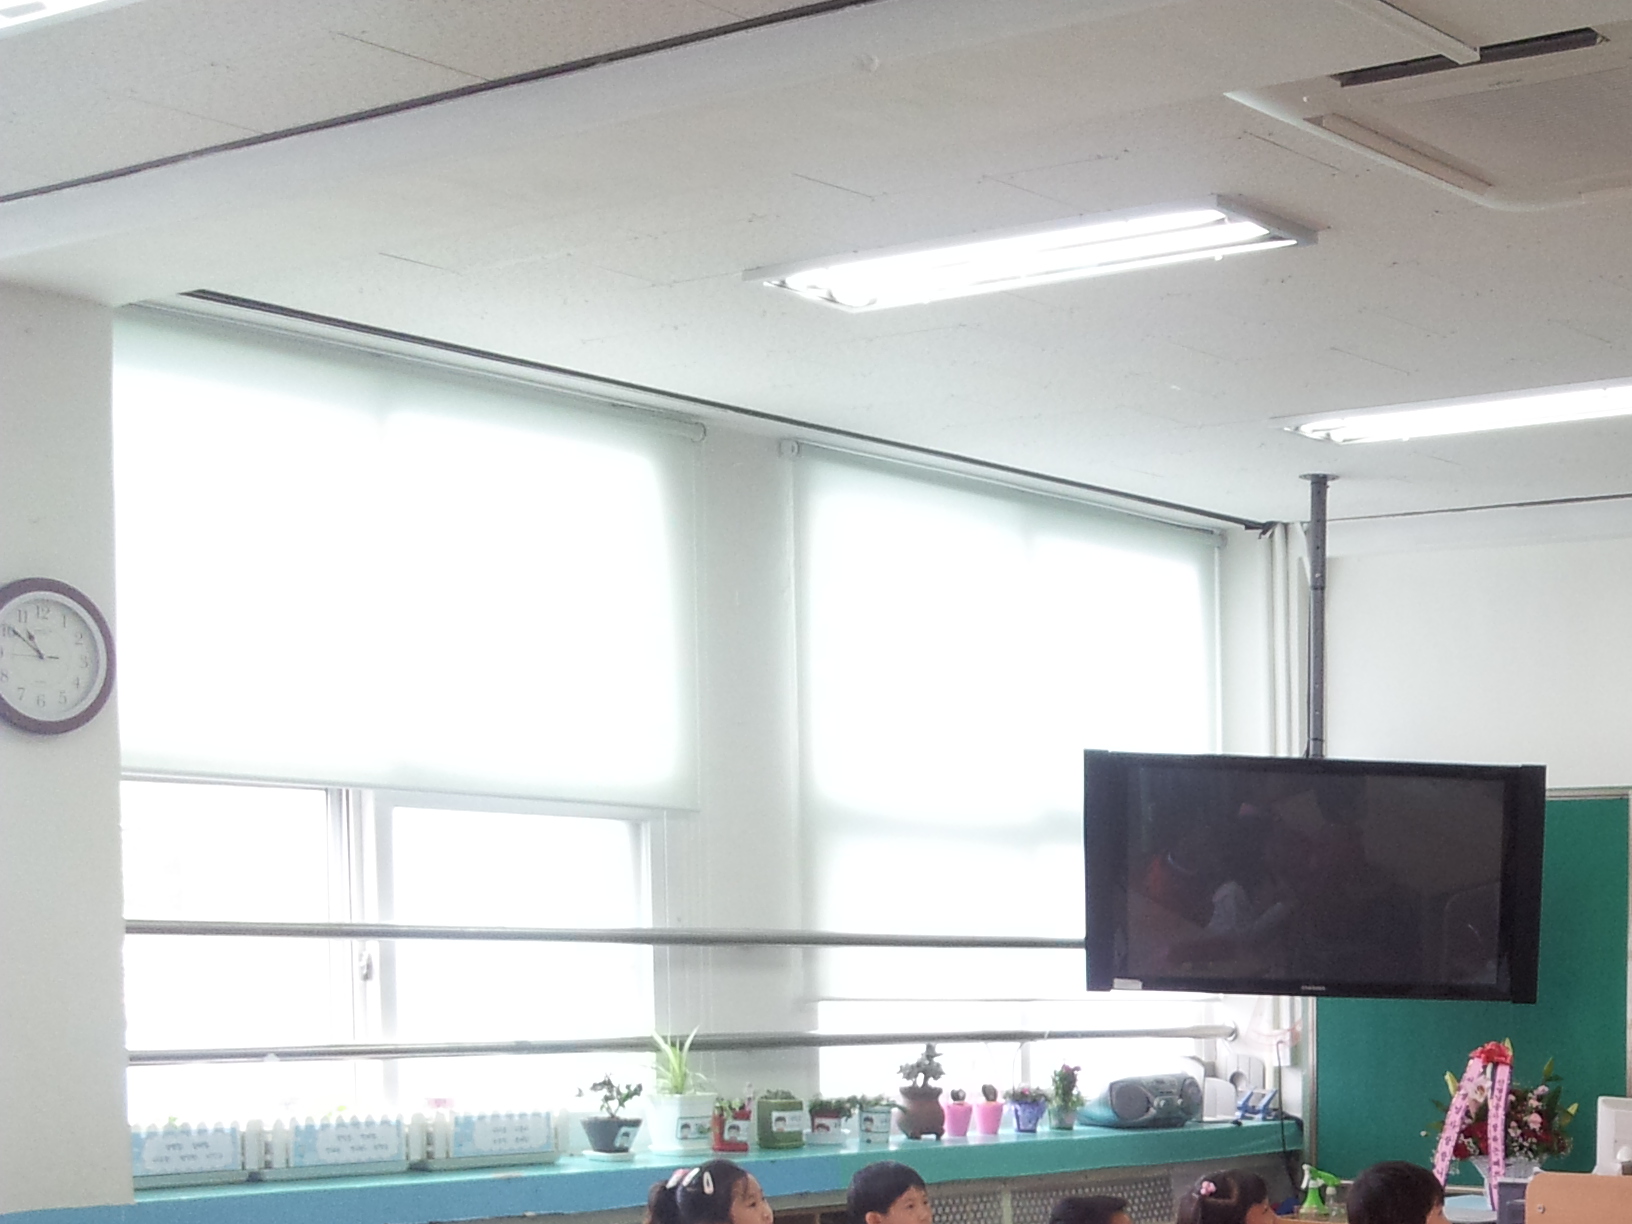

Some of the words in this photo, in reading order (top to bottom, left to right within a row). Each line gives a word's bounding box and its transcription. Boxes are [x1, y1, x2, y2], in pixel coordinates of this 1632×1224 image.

[17, 609, 28, 623] 11
[36, 605, 50, 620] 12
[62, 615, 67, 628] 1
[75, 633, 83, 645] 2
[80, 656, 89, 668] 3
[74, 676, 80, 689] 4
[18, 687, 25, 700] 7
[59, 692, 67, 704] 5
[37, 695, 46, 708] 6
